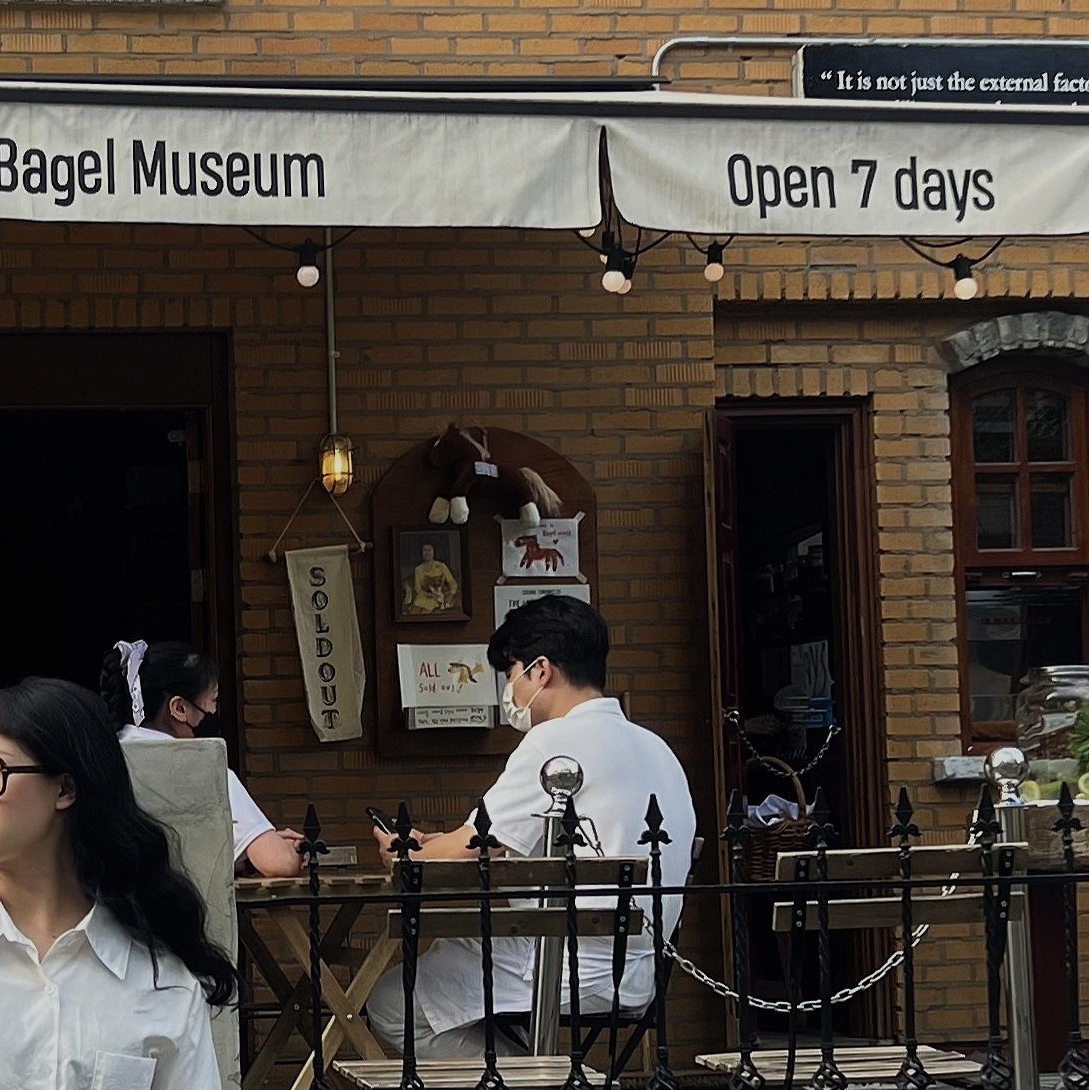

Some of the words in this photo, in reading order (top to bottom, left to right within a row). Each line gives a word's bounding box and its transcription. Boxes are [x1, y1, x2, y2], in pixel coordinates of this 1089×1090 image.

[837, 70, 855, 91] It
[856, 70, 872, 91] is
[876, 75, 908, 92] not
[910, 70, 944, 97] just
[947, 70, 976, 92] the
[979, 71, 1049, 93] external
[132, 139, 326, 198] Museum
[727, 153, 837, 218] Open
[850, 159, 878, 209] 7
[894, 156, 996, 222] days
[419, 661, 442, 679] ALL
[418, 682, 436, 694] Sold
